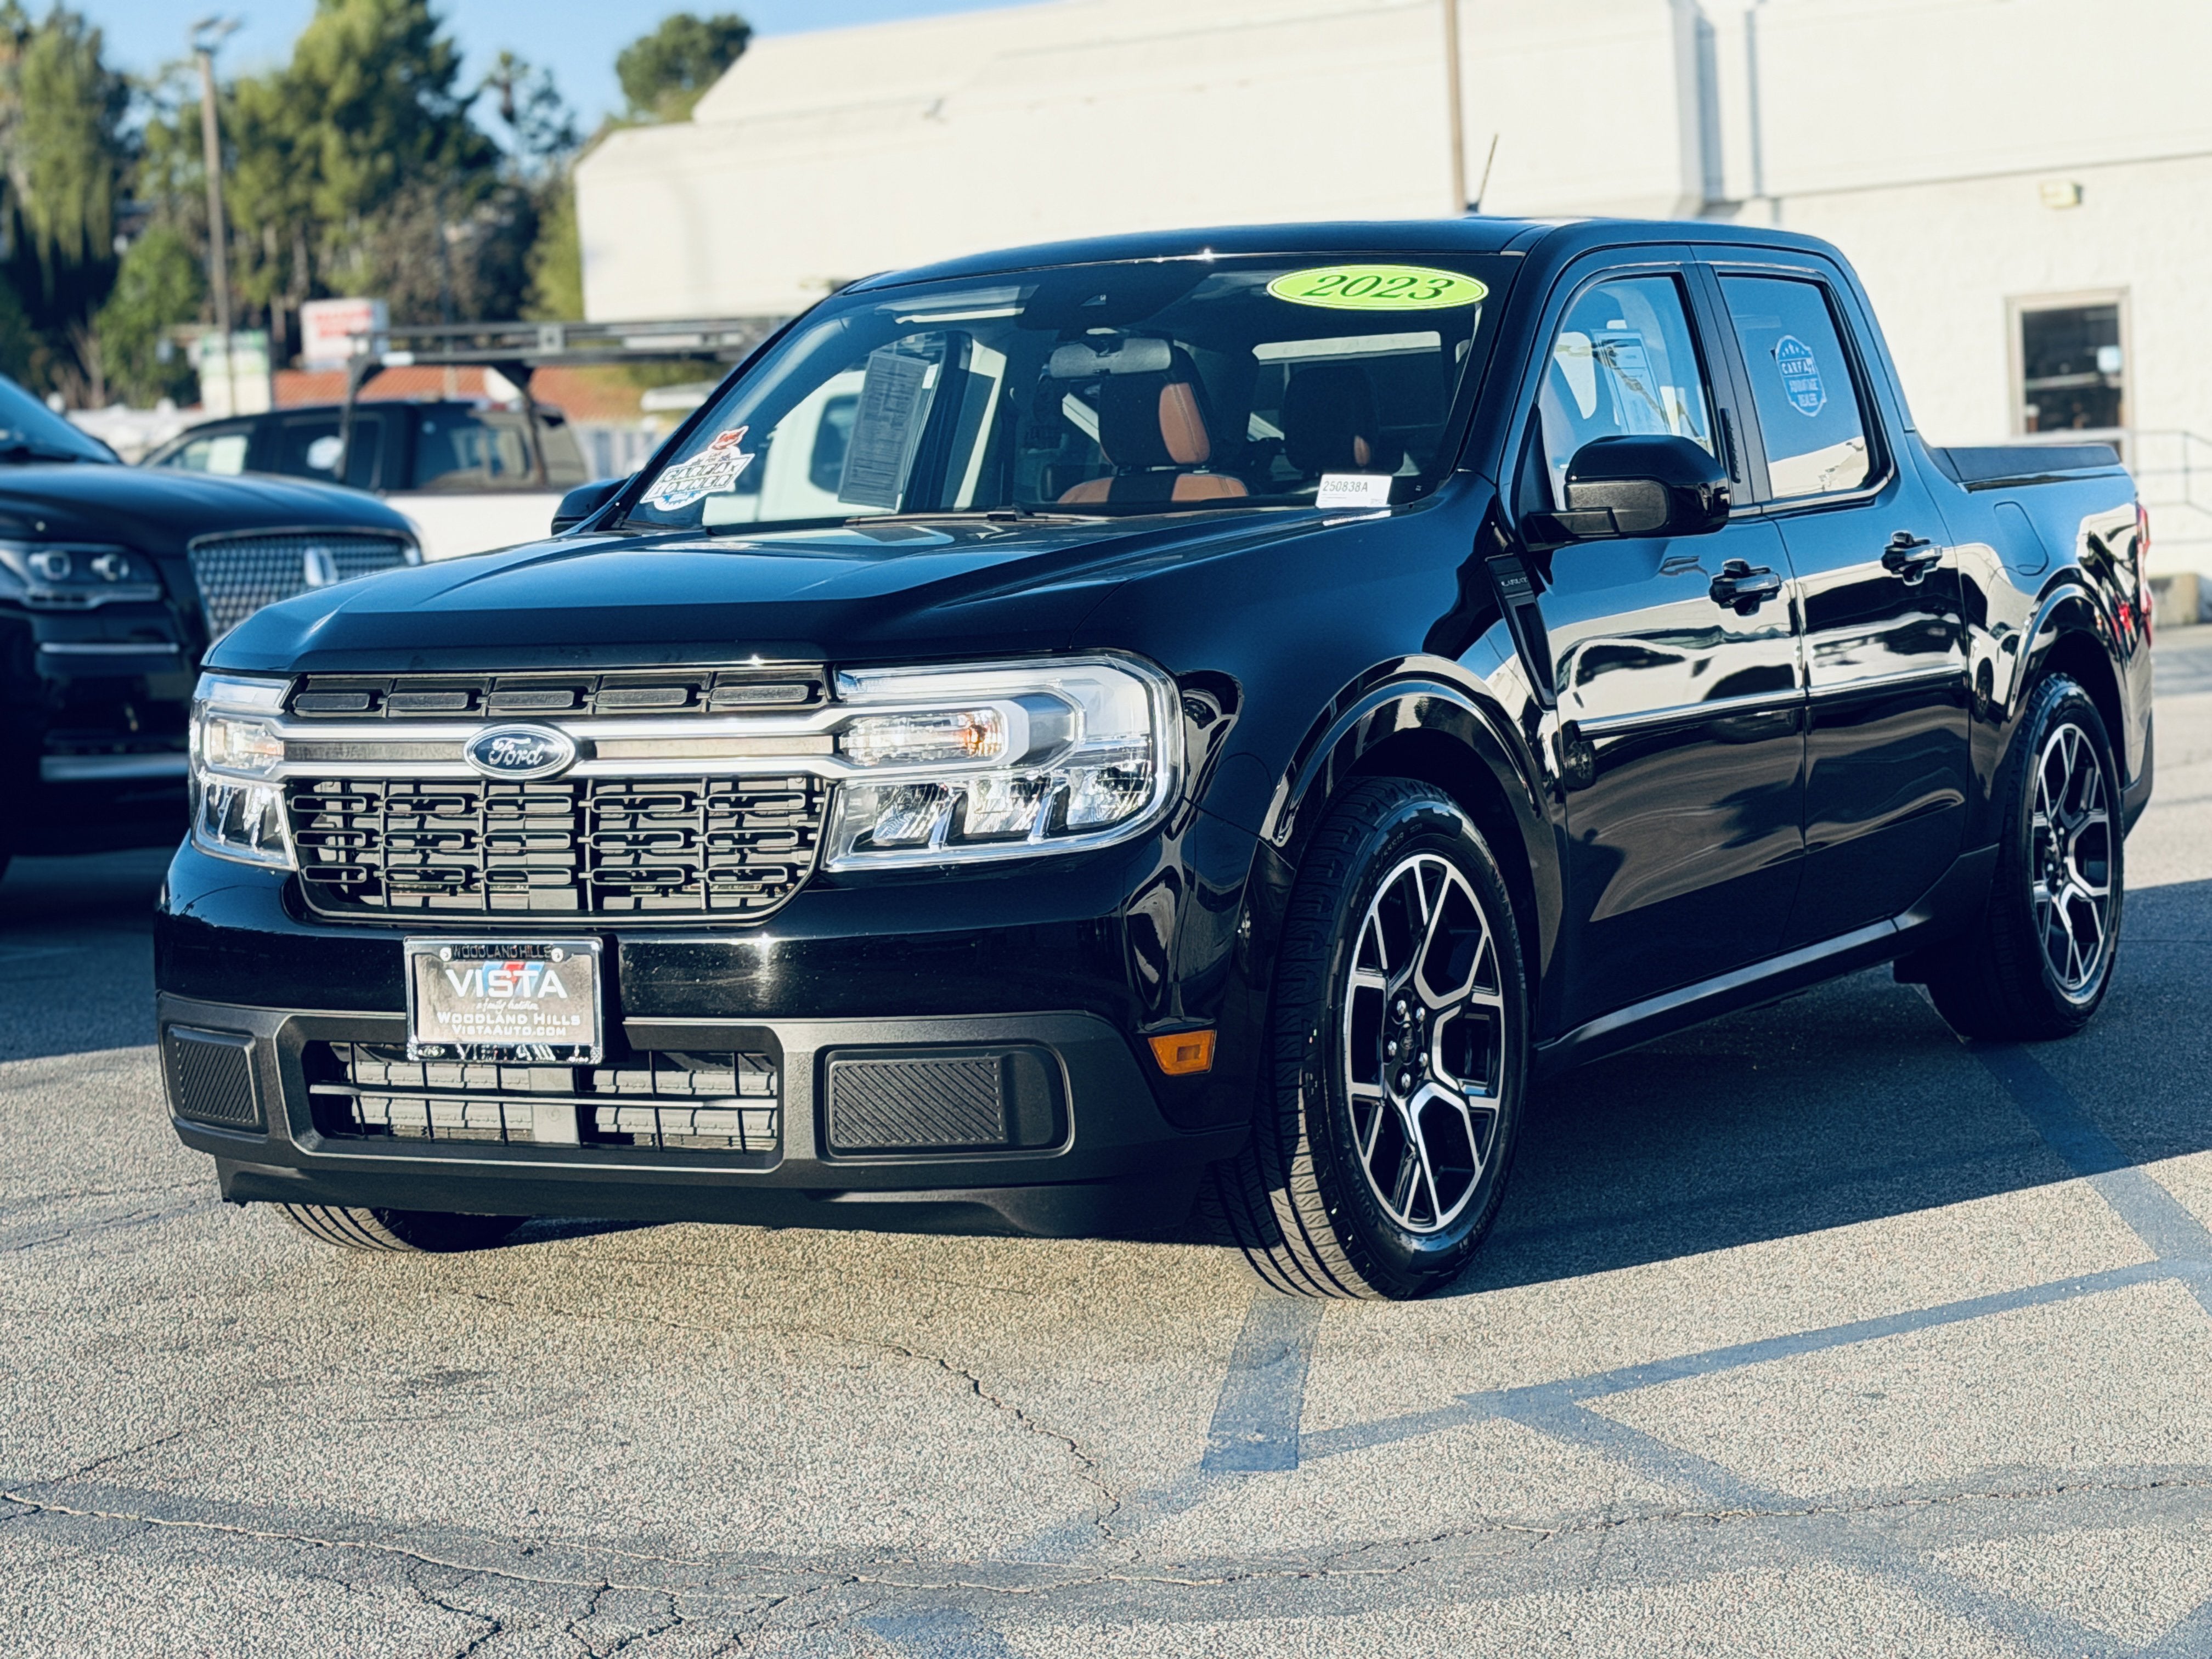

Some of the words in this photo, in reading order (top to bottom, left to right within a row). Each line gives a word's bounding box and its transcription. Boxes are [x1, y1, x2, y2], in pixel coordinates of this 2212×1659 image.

[1300, 275, 1455, 300] 2023
[663, 462, 740, 482] CARFAX
[664, 475, 731, 492] OWNER
[1322, 480, 1368, 493] 250838A
[489, 737, 545, 766] Ford
[452, 944, 518, 958] WOODLAND
[518, 944, 552, 958] HILLS
[445, 968, 568, 999] VISTA
[437, 1011, 528, 1025] WOODLAND
[533, 1012, 581, 1026] HILLS
